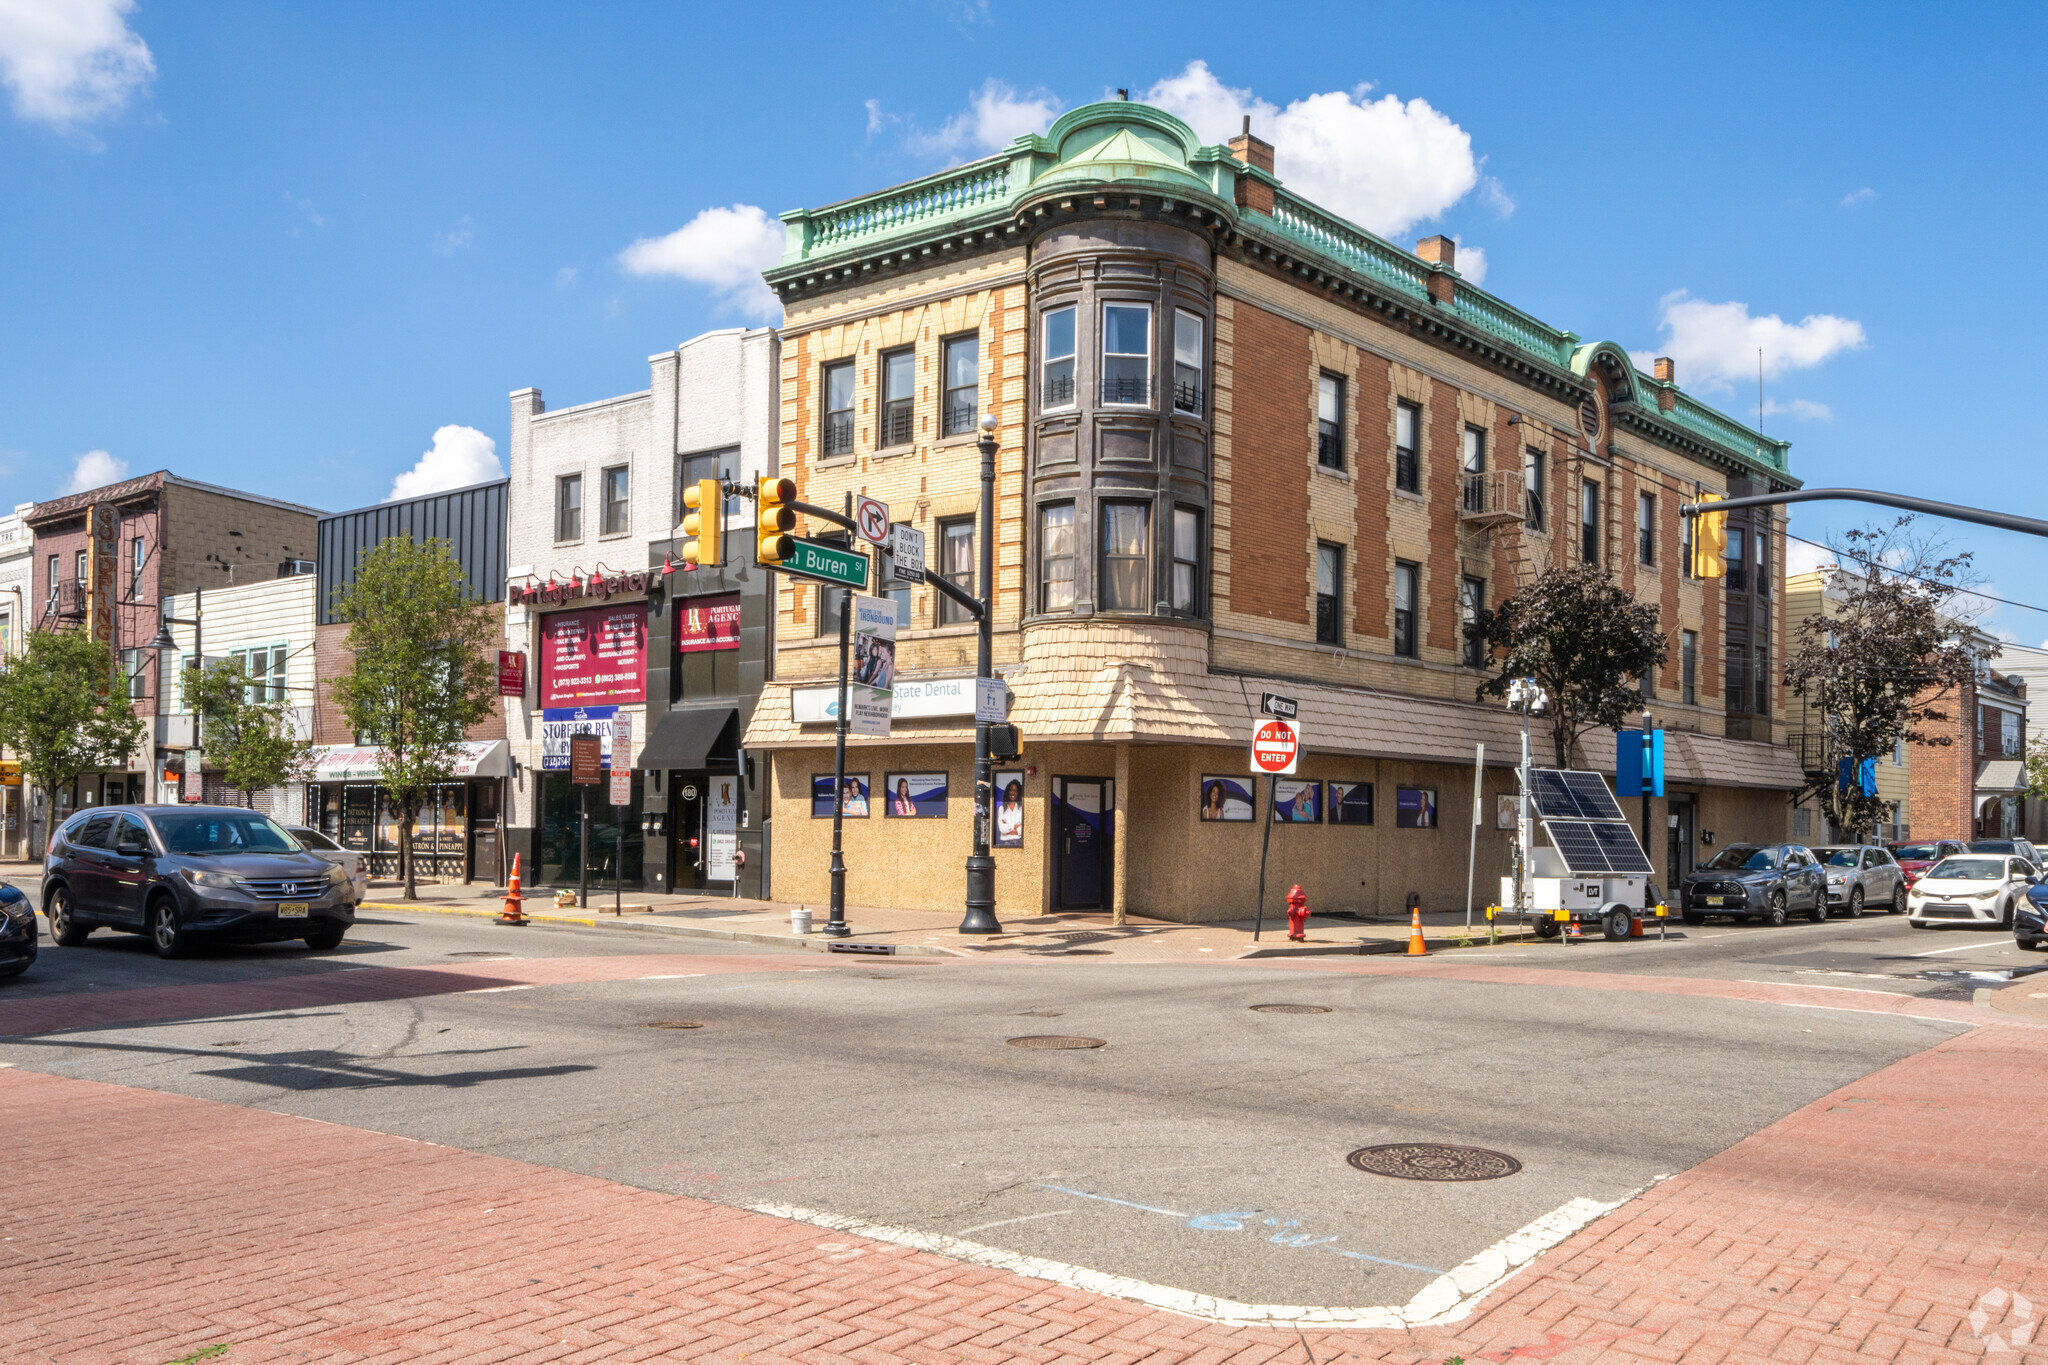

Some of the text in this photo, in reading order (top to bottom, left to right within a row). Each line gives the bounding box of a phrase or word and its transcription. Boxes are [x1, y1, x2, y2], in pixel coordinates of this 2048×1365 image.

[1, 532, 13, 542] TRE
[900, 543, 919, 557] BLOCK
[806, 550, 847, 576] Buren
[855, 562, 862, 571] St
[896, 554, 923, 570] THE BOX
[96, 508, 113, 672] GOLDFING
[585, 573, 652, 600] Agency
[708, 613, 740, 623] AGENC
[861, 612, 894, 626] IRONBOUND
[599, 650, 622, 658] INSURANCE
[893, 682, 961, 699] State Dental
[1275, 701, 1295, 712] ONE WAY
[543, 722, 612, 739] STORE FOR REN
[1260, 730, 1292, 740] DO NOT
[561, 741, 570, 753] BY
[1261, 753, 1287, 763] ENTER
[684, 789, 696, 797] 180
[413, 842, 429, 850] TRÓN
